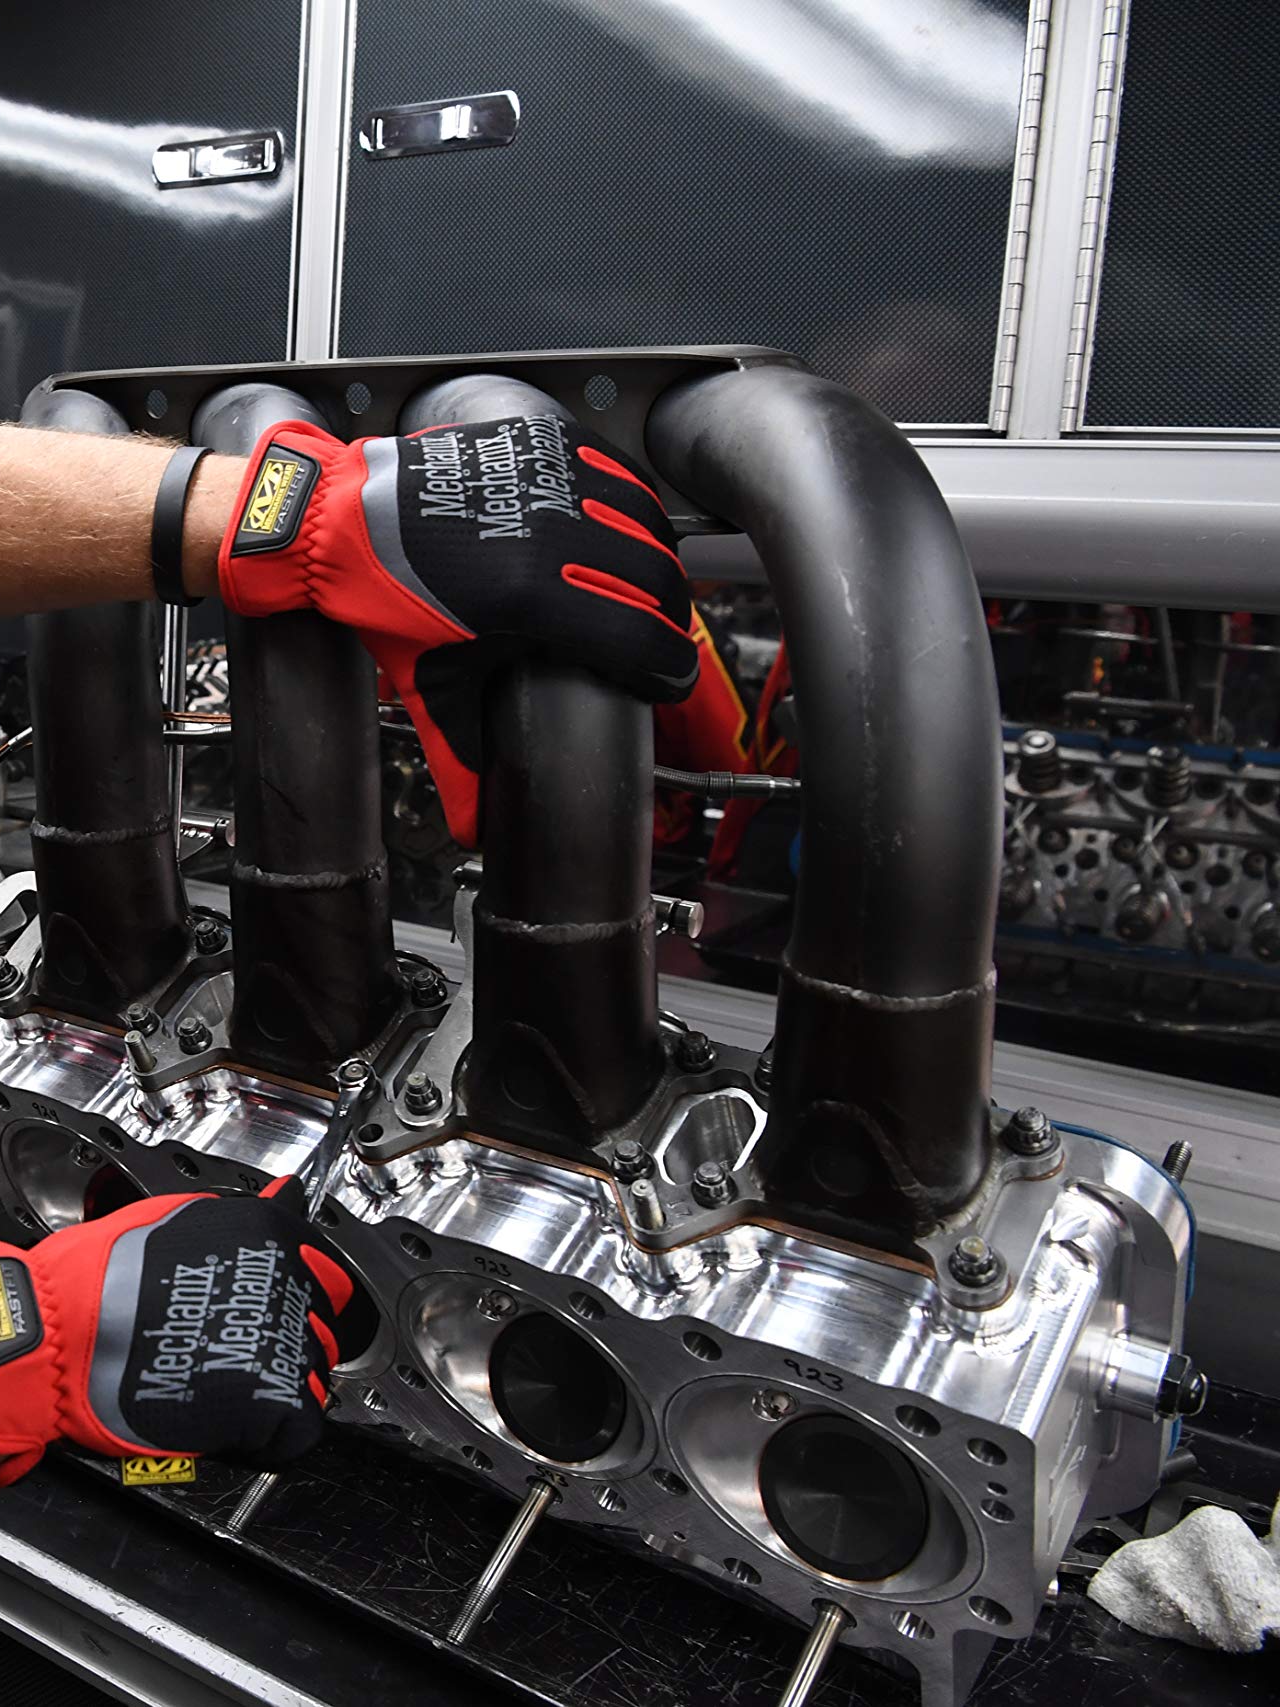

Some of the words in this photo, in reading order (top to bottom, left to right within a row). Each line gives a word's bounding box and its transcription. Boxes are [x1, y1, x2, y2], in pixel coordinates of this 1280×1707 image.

[273, 464, 305, 534] FASTFIT
[408, 433, 467, 518] Mechanix
[465, 430, 523, 539] Mechanix
[238, 1173, 268, 1192] 92
[474, 1256, 512, 1277] 923
[134, 1263, 216, 1401] Mechanix
[202, 1246, 277, 1374] Mechanix
[253, 1275, 307, 1409] Mechanix
[783, 1358, 844, 1391] 923
